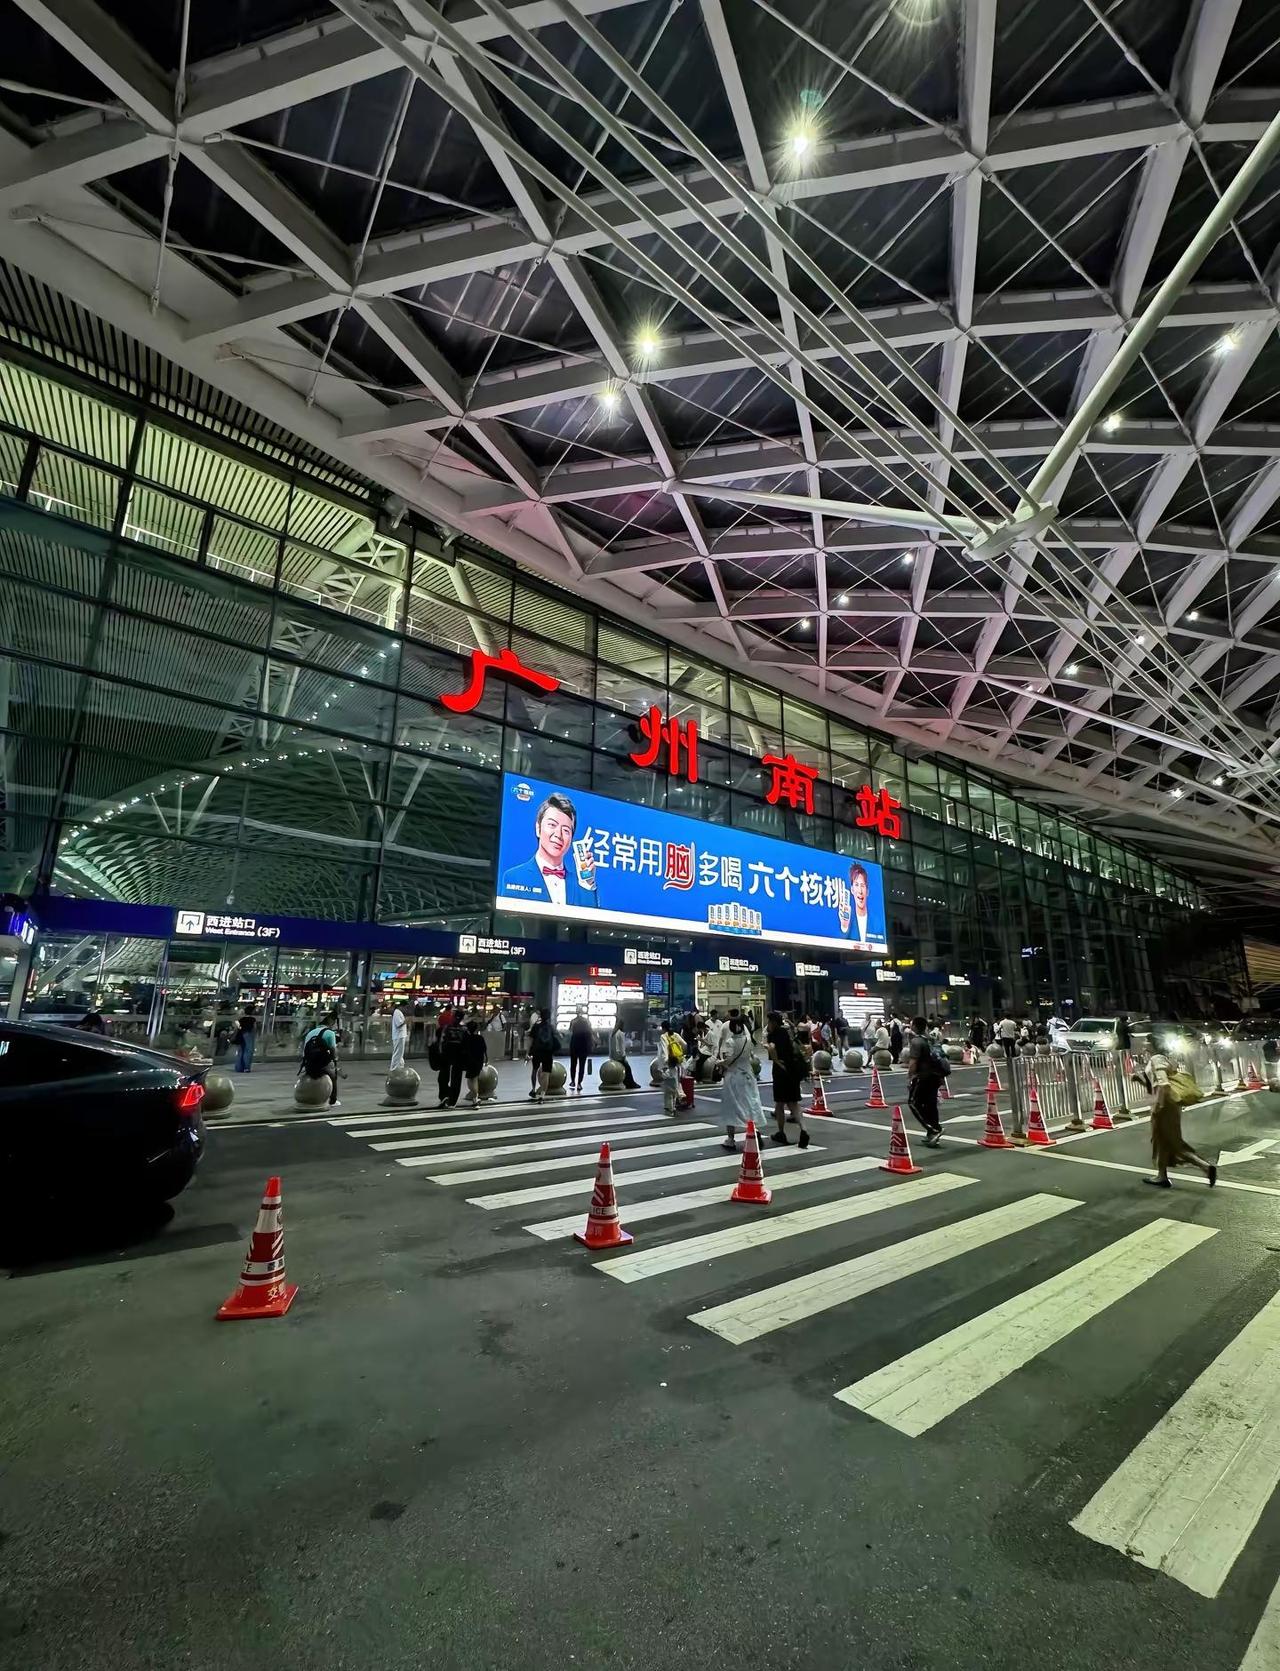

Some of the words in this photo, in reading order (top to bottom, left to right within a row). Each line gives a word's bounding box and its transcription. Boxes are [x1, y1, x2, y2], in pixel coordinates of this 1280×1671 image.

[439, 648, 901, 838] 广州南站
[206, 915, 256, 929] 西进站口
[205, 926, 223, 935] West
[224, 928, 256, 937] Entrance
[257, 926, 280, 938] (3F)
